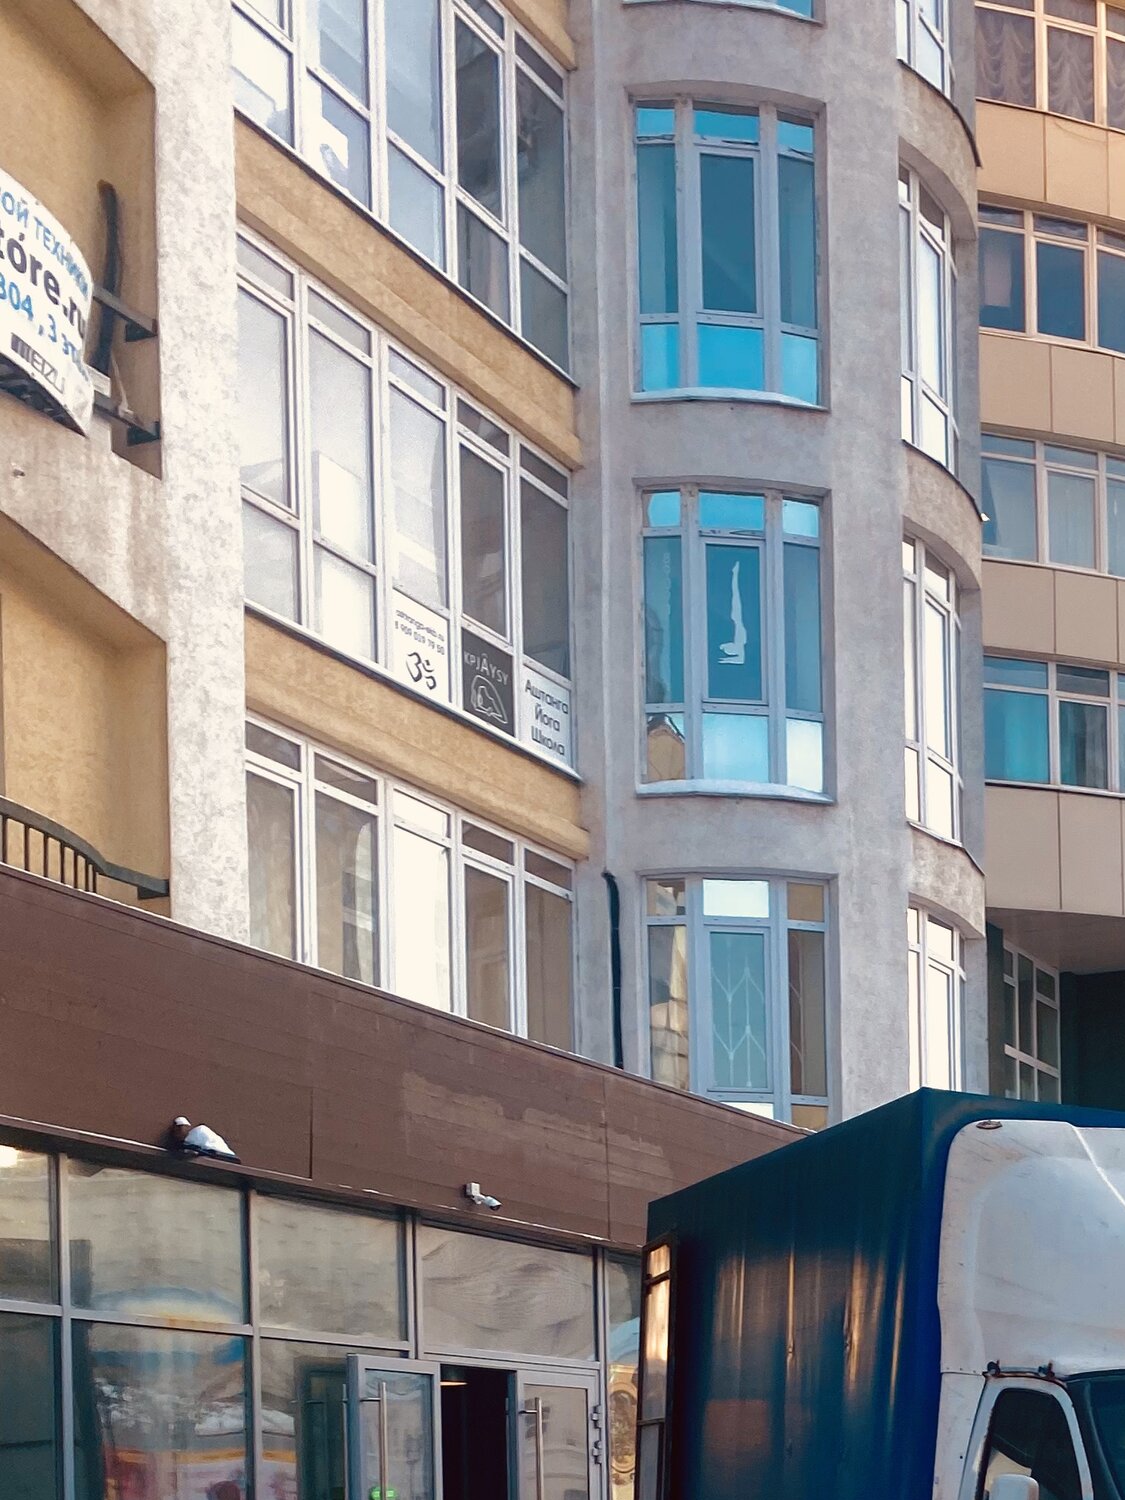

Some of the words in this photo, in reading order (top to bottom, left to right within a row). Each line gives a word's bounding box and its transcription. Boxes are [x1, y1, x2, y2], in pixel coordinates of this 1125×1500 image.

[0, 186, 29, 230] ОЙ
[10, 331, 66, 395] MEIZU
[525, 679, 570, 715] Аштанга
[534, 702, 561, 732] Йога
[531, 725, 566, 757] Школа
